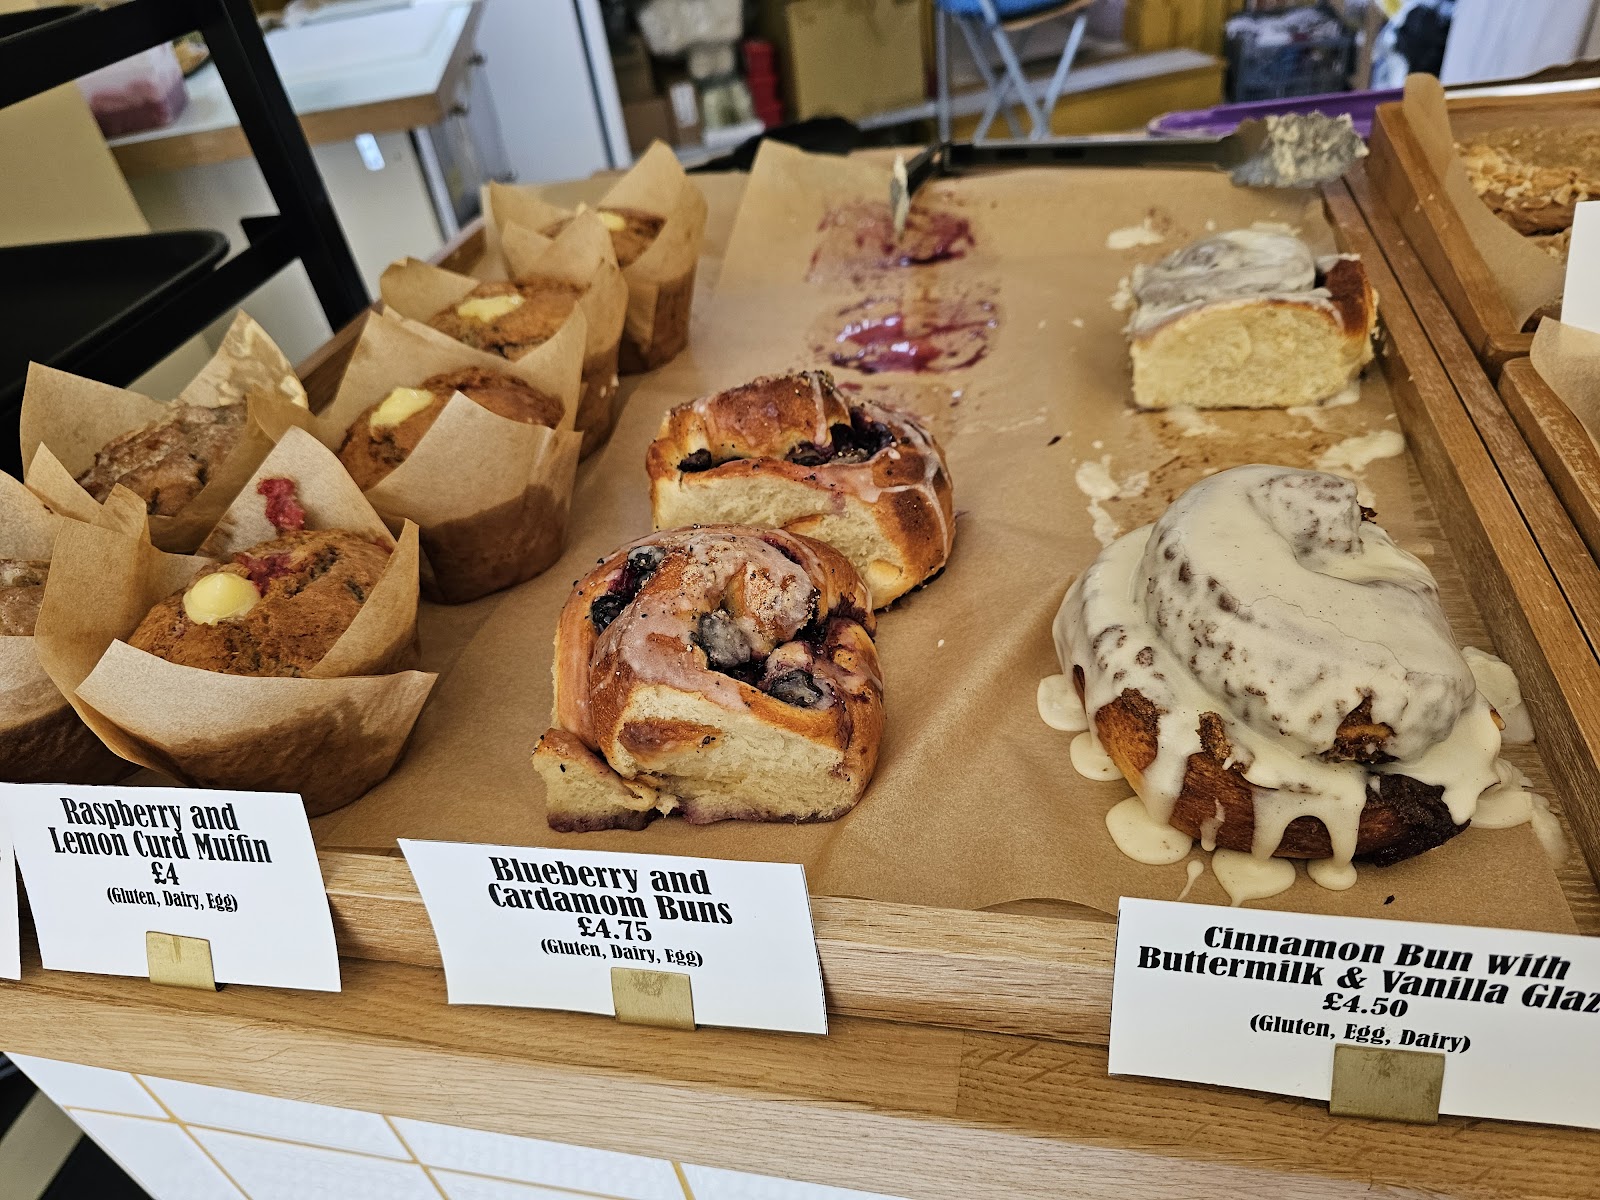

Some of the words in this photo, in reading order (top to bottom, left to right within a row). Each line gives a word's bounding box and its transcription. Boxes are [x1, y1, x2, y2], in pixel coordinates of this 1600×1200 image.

[60, 797, 182, 832] Raspberry
[190, 803, 240, 831] and
[48, 827, 130, 857] Lemon
[133, 830, 190, 860] Curd
[192, 833, 272, 863] Muffin
[151, 861, 180, 885] £4
[488, 857, 638, 893] Blueberry
[650, 869, 712, 895] and
[107, 887, 161, 907] (Gluten,
[163, 890, 204, 910] Dairy,
[208, 892, 238, 912] Egg)
[488, 883, 648, 918] Cardamom
[654, 895, 733, 924] Buns
[578, 916, 652, 942] £4.75
[541, 938, 607, 959] (Gluten,
[610, 944, 661, 964] Dairy,
[665, 948, 704, 968] Egg)
[1204, 926, 1385, 964] Cinnamon
[1394, 943, 1473, 972] Bun
[1487, 953, 1571, 980] with
[1137, 945, 1325, 986] Buttermilk
[1337, 966, 1368, 989] &
[1383, 970, 1509, 1004] Vanilla
[1322, 992, 1409, 1017] £4.50
[1250, 1014, 1336, 1040] (Gluten,
[1343, 1023, 1391, 1046] Egg,
[1399, 1029, 1471, 1053] Dairy)
